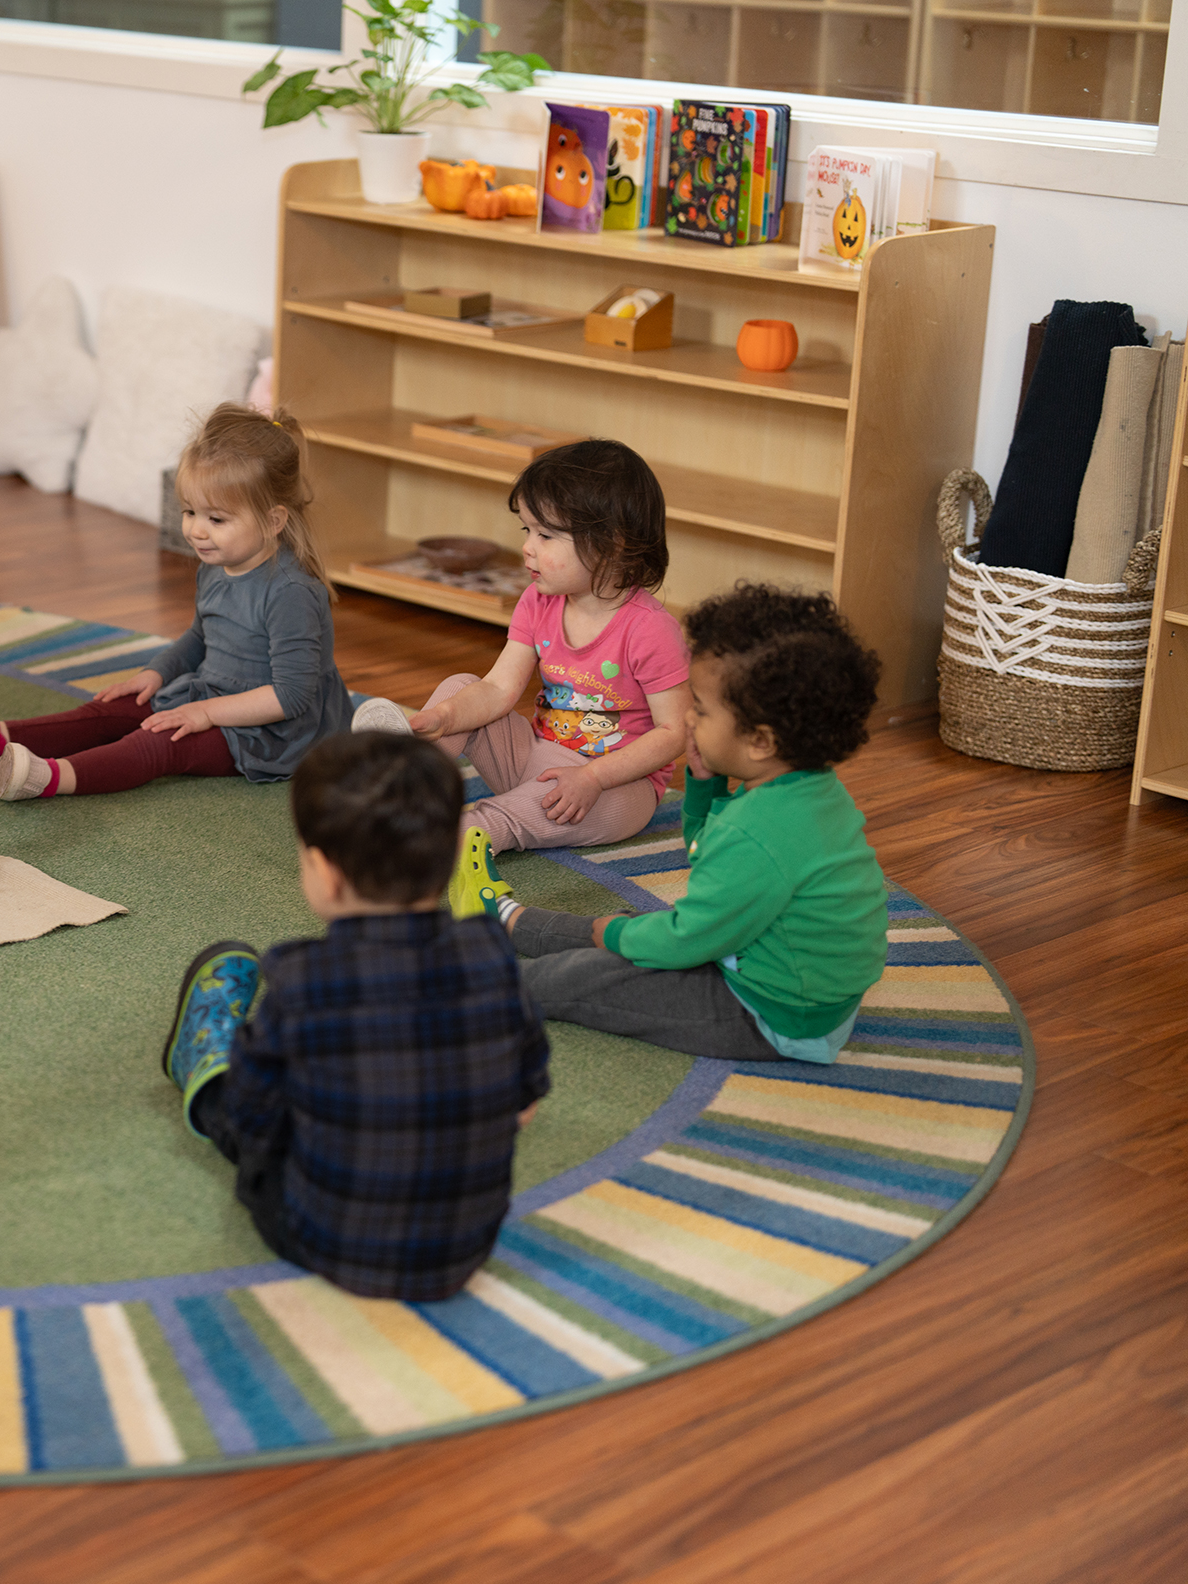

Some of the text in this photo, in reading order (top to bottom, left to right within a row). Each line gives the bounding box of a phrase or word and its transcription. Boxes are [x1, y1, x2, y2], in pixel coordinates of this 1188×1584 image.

[692, 118, 728, 135] PUMPKINS
[832, 157, 858, 173] PUMPKIN
[567, 665, 633, 710] Neighborhood!
